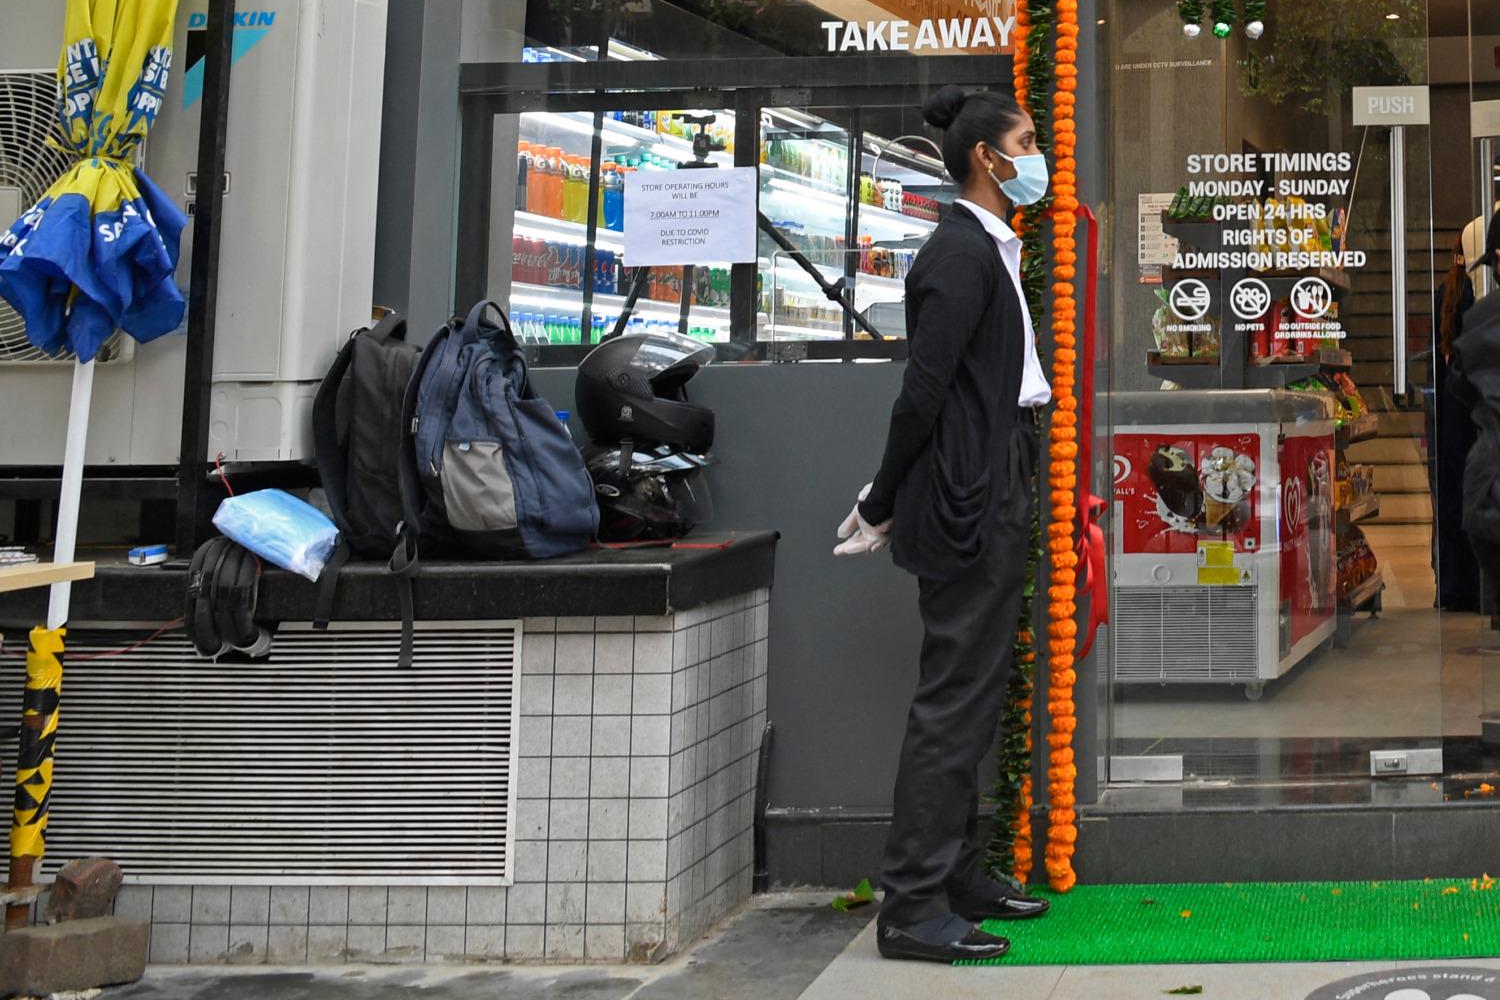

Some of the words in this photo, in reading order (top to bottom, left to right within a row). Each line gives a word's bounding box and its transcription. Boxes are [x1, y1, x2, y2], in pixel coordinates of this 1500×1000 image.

[187, 11, 276, 28] DKIN
[820, 19, 910, 53] TAKE
[914, 16, 1016, 50] AWAY
[1367, 95, 1415, 115] PUSH
[1186, 153, 1257, 174] STORE
[1261, 151, 1352, 173] TIMINGS
[641, 183, 664, 192] STORE
[664, 182, 703, 191] OPERATING
[704, 181, 729, 190] HOURS
[1188, 180, 1264, 197] MONDAY
[1279, 178, 1350, 196] SUNDAY
[671, 192, 688, 200] WILL
[678, 210, 687, 218] TO
[1212, 204, 1261, 221] OPEN
[1263, 203, 1287, 220] 24
[1290, 202, 1327, 220] HRS
[677, 229, 686, 237] TO
[687, 228, 709, 236] COVID
[1222, 228, 1288, 246] RIGHTS
[1290, 228, 1313, 245] OF
[661, 238, 706, 246] RESTRICTION
[1172, 252, 1273, 270] ADMISSION
[1275, 250, 1367, 268] RESERVED
[1166, 324, 1178, 332] NO
[1178, 324, 1212, 332] SMOKING
[1235, 323, 1246, 331] NO
[1246, 323, 1265, 331] PETS
[1279, 322, 1290, 331] NO
[1290, 322, 1320, 330] OUTSIDE
[1321, 322, 1342, 330] FOOD
[1312, 331, 1347, 339] ALLOWED
